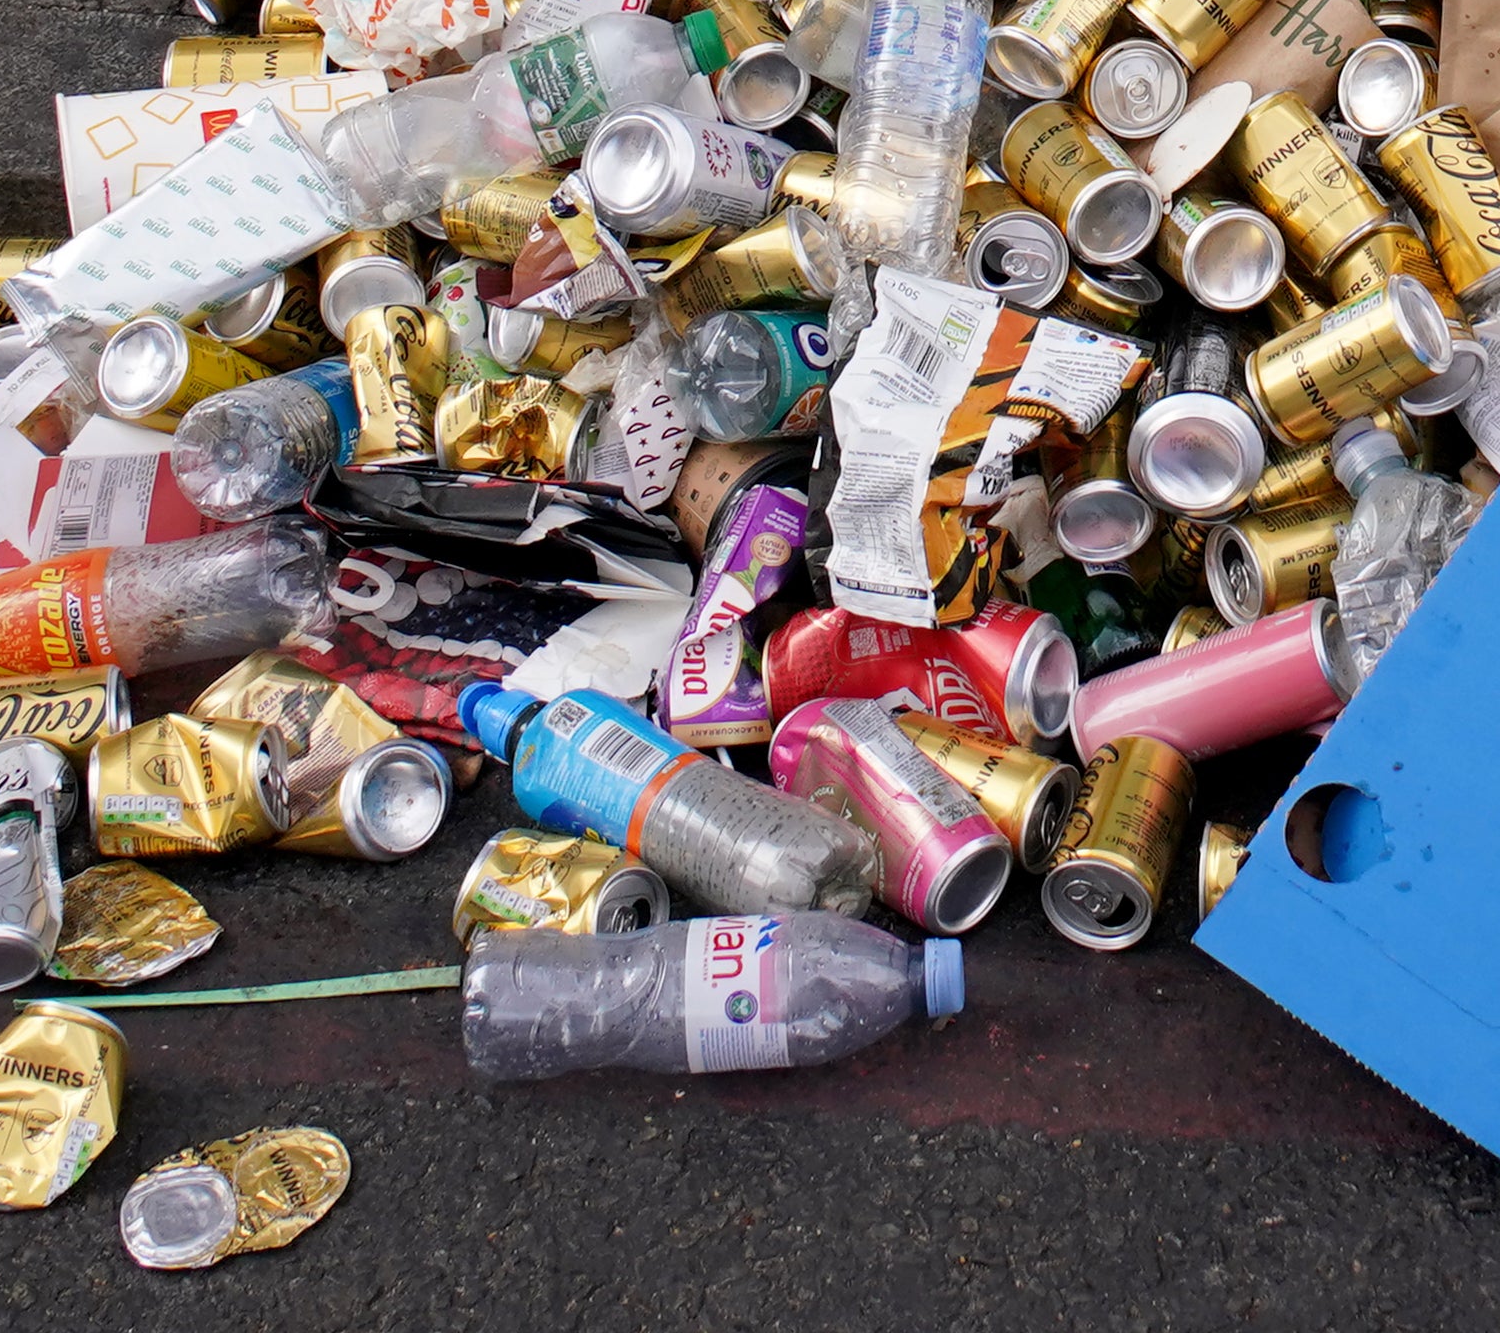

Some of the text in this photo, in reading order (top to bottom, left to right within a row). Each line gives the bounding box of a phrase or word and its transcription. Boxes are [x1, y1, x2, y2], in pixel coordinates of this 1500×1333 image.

[224, 134, 256, 154] PEPERO
[269, 132, 302, 155] PEPERO
[1019, 120, 1075, 191] WINNERS
[1250, 123, 1324, 184] WINNERS
[253, 174, 285, 195] PEPERO
[1292, 350, 1347, 428] WINNERS
[40, 567, 76, 673] cozade
[67, 591, 92, 663] ENERGY
[90, 594, 113, 656] ORANGE
[689, 726, 769, 739] BLACKCURRANT
[712, 918, 753, 979] vian
[79, 1044, 110, 1118] RECYCLE ME
